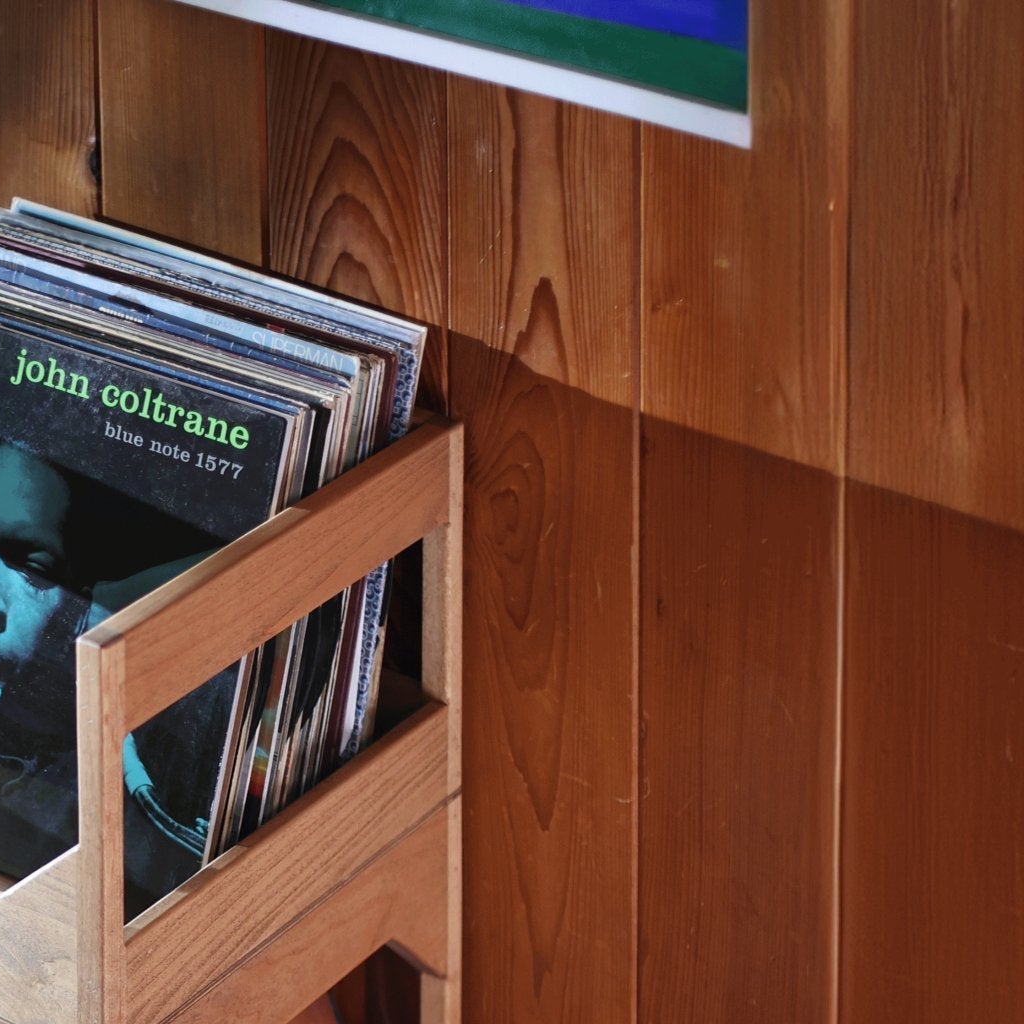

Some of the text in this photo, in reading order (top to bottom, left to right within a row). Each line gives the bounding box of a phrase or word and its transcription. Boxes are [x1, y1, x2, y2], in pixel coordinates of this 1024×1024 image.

[251, 331, 344, 372] SUPERMAN
[10, 349, 250, 450] john coltrane
[104, 421, 244, 480] blue note 1577
